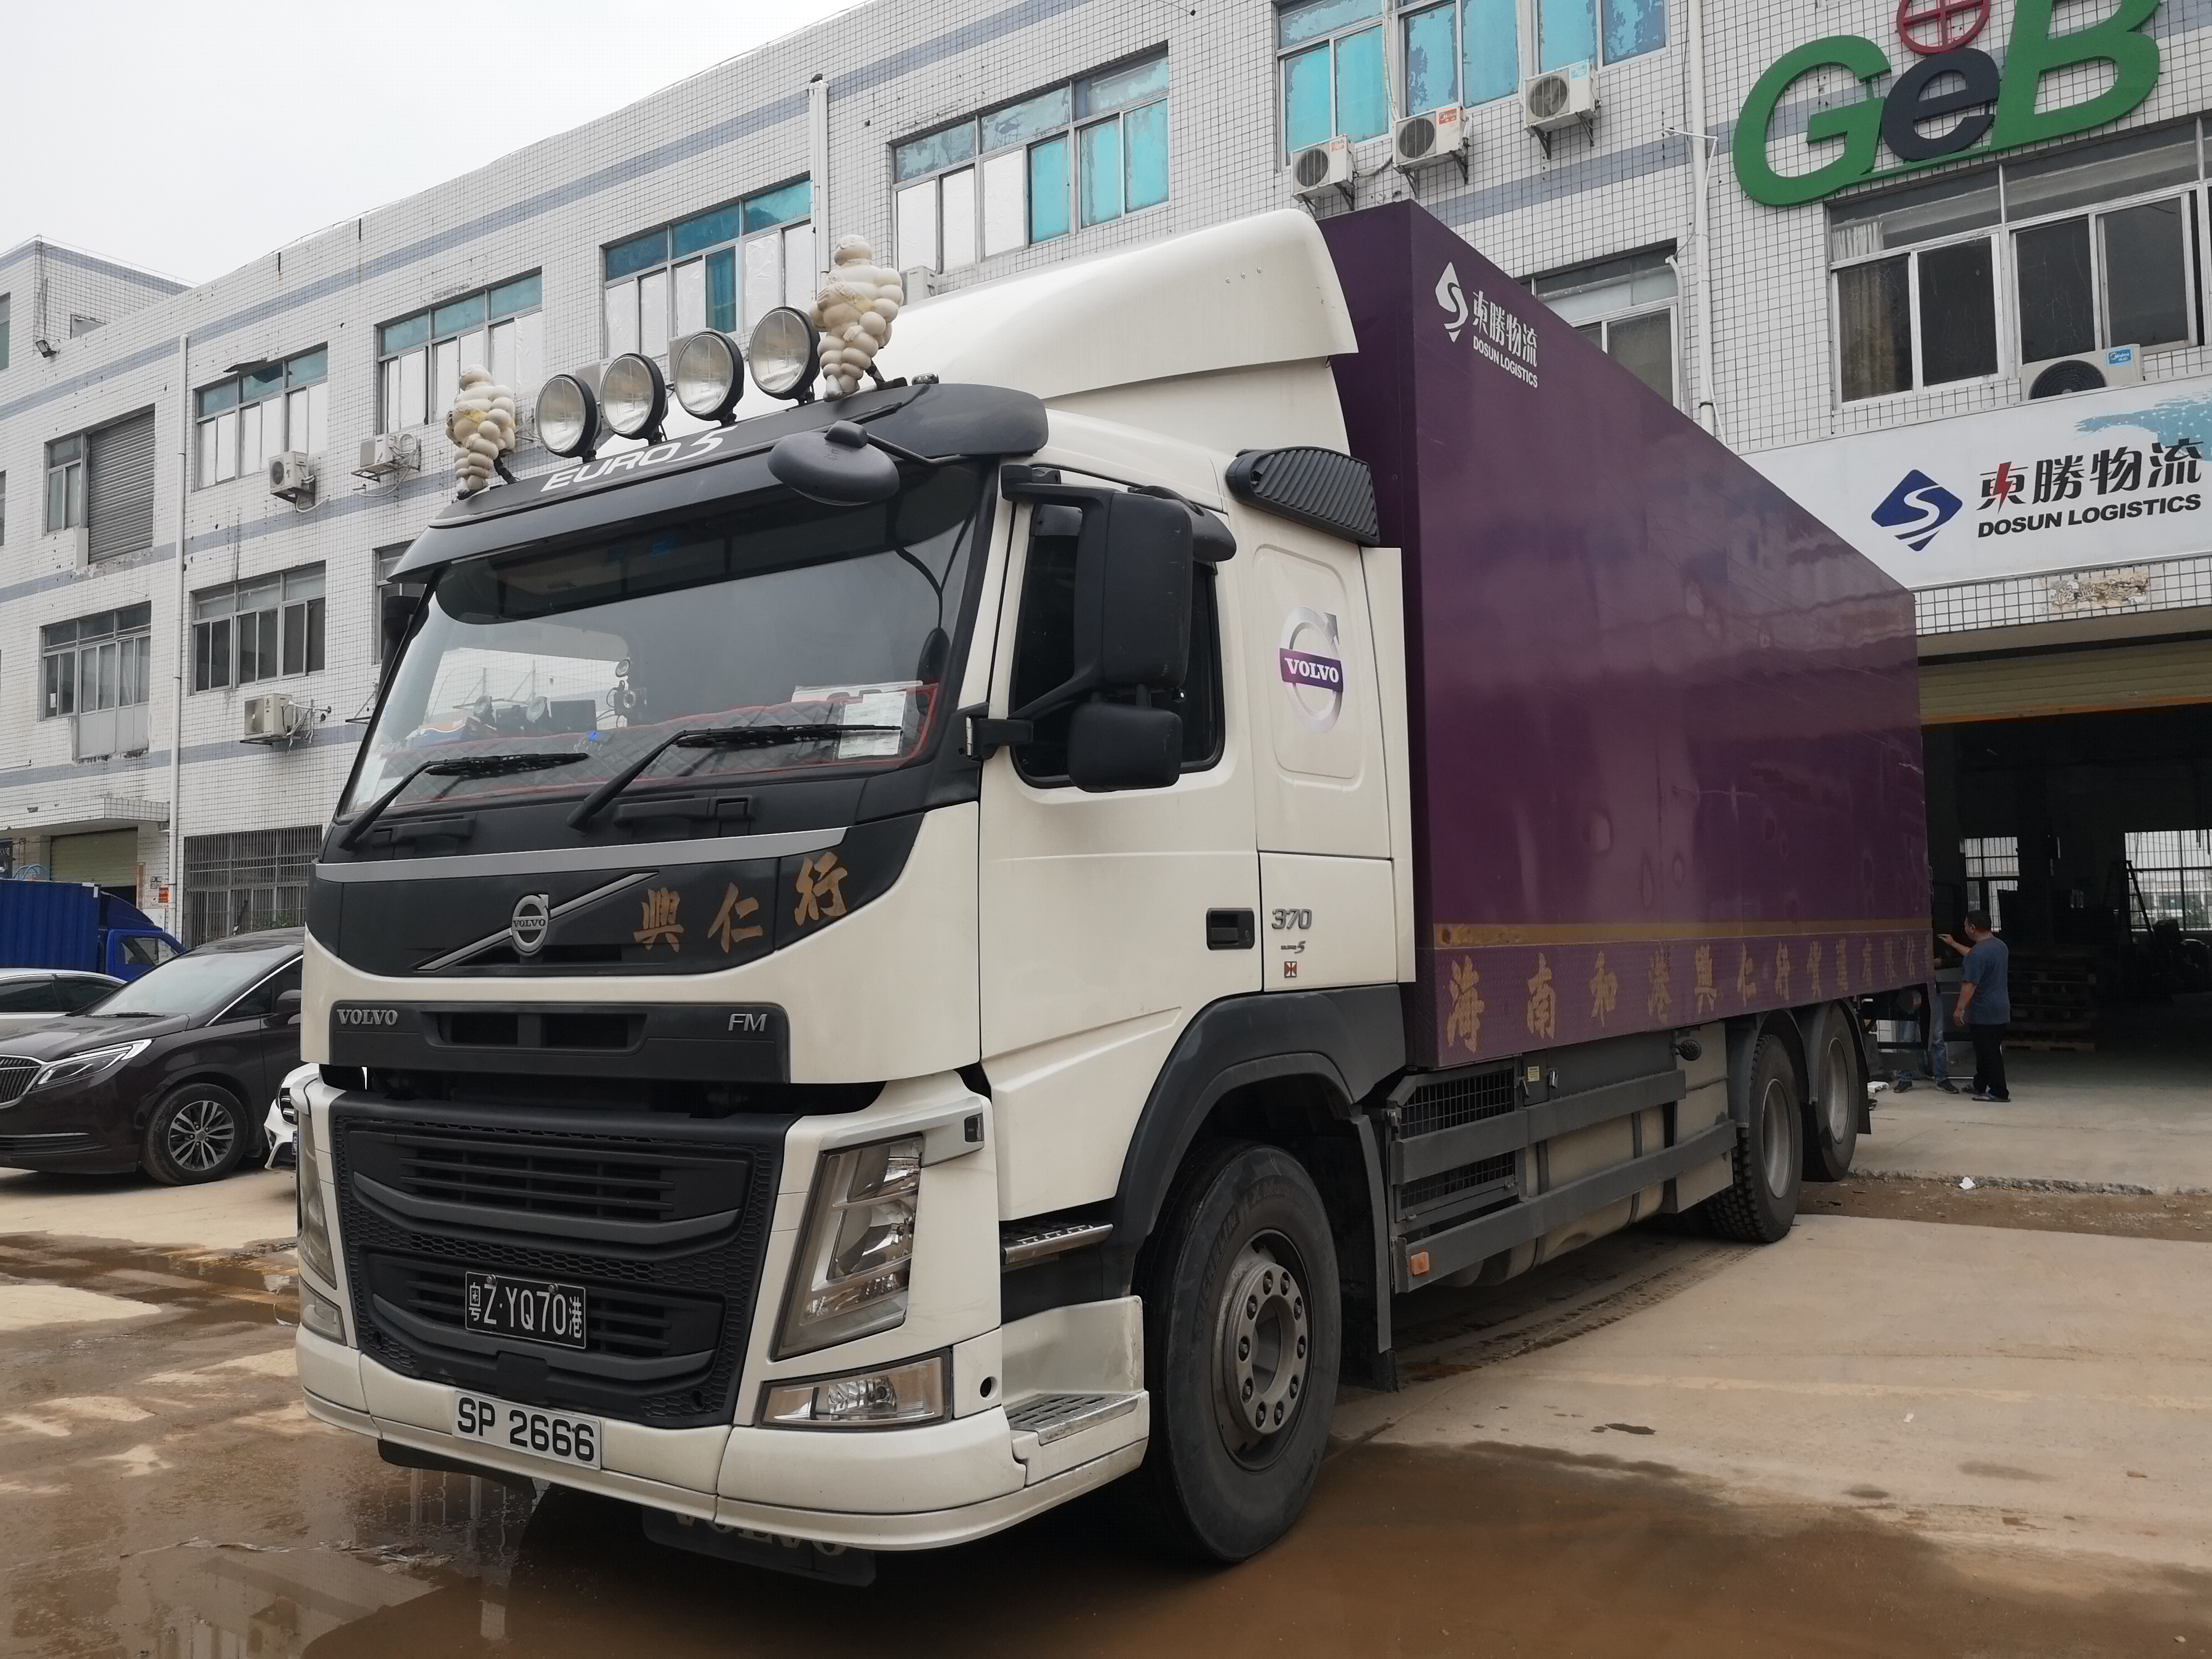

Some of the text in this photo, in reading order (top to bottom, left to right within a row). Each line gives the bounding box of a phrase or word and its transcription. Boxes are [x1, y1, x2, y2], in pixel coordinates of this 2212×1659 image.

[1472, 290, 1538, 368] 東勝物流
[1473, 335, 1538, 389] DOSUN LOGISTICS
[1976, 438, 2204, 514] 東勝物流
[1977, 493, 2201, 538] DOSUN LOGISTICS
[1284, 657, 1340, 683] VOLVO
[513, 919, 546, 928] VOLVO
[1271, 908, 1312, 929] 370
[336, 1009, 397, 1026] VOLVO
[728, 1013, 768, 1031] FM
[457, 1397, 594, 1462] SP 2666
